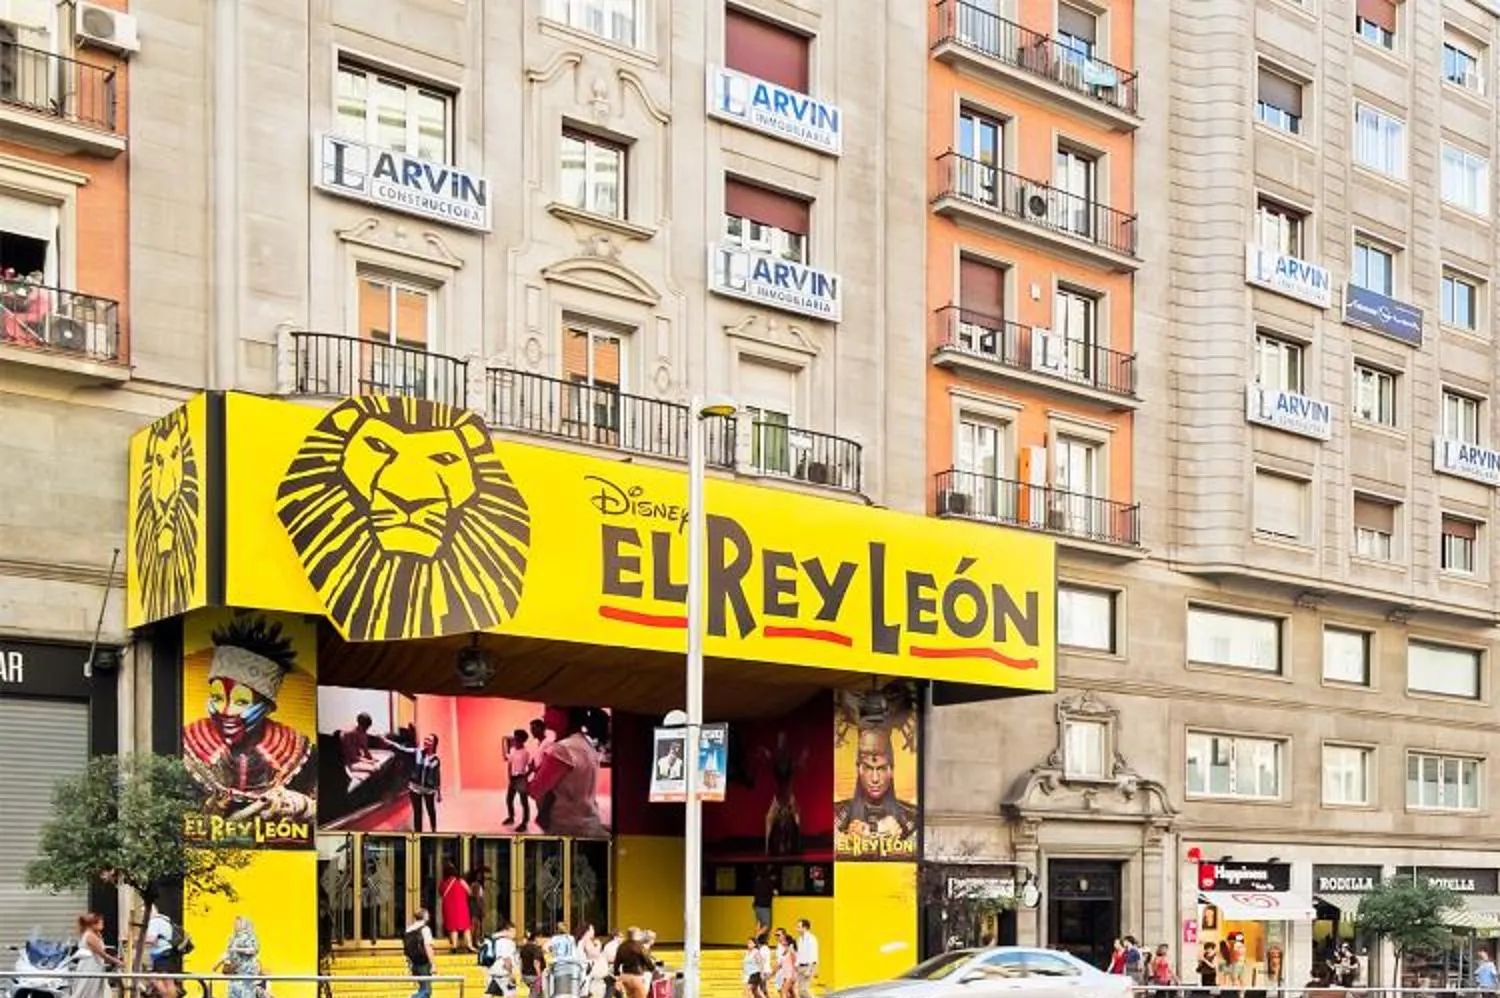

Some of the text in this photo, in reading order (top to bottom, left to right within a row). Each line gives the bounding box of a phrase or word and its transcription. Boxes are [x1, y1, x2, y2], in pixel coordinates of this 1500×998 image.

[379, 185, 481, 221] CONSTRUCTORA
[601, 513, 1039, 655] EL REY LEÓN
[184, 814, 207, 835] EL
[255, 816, 308, 843] LEÓN
[1319, 877, 1374, 890] RODILLA
